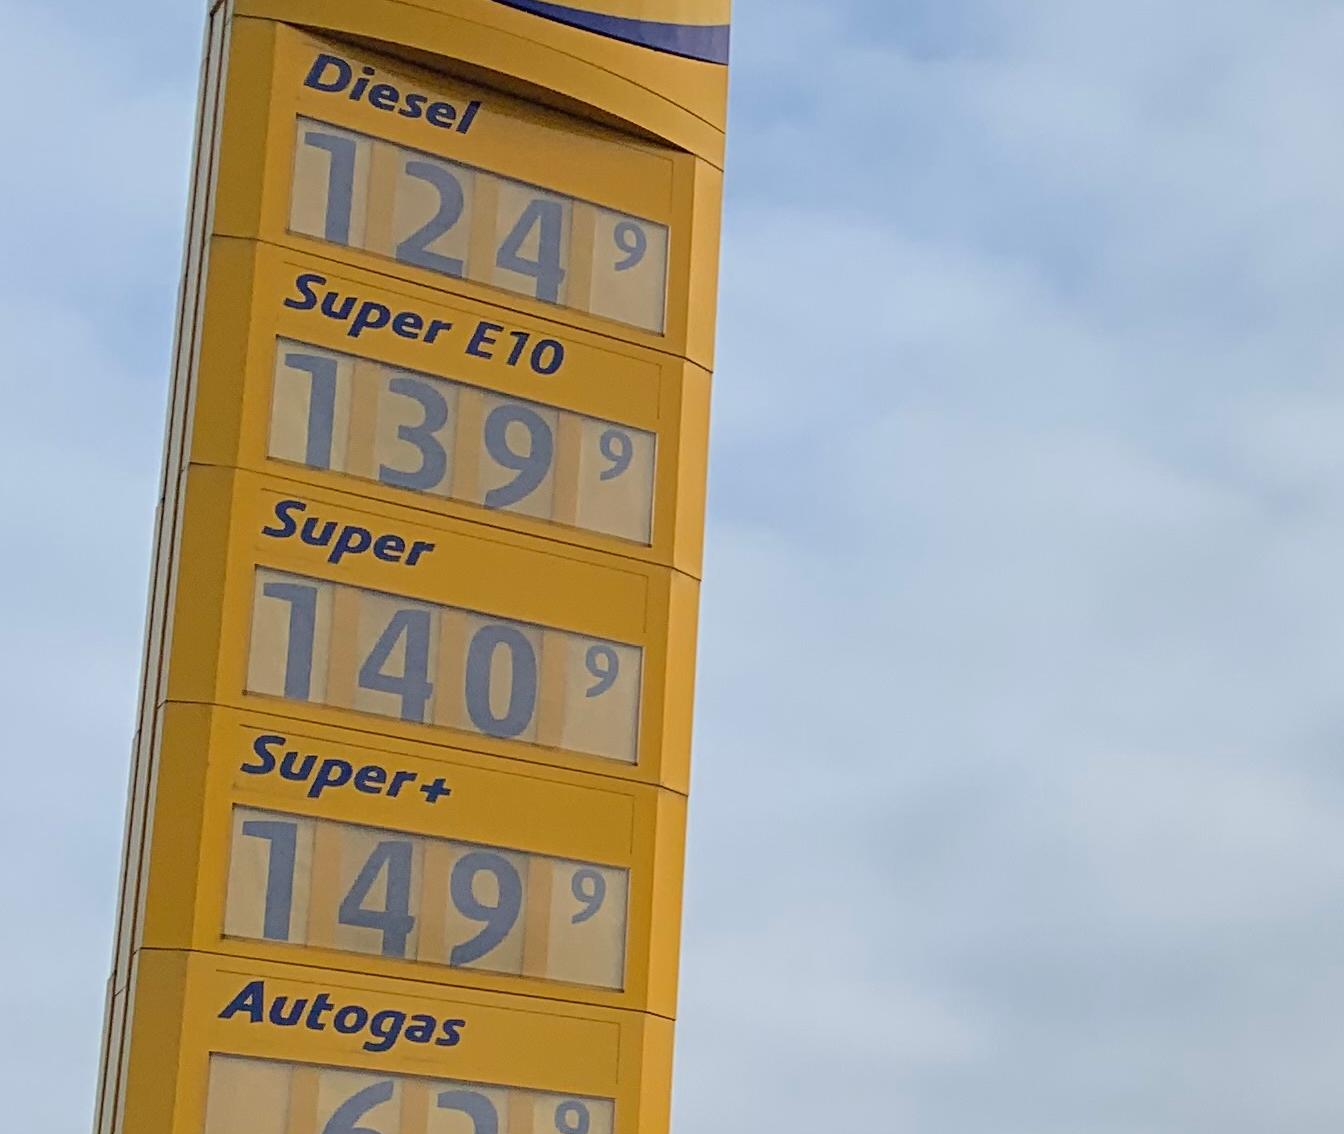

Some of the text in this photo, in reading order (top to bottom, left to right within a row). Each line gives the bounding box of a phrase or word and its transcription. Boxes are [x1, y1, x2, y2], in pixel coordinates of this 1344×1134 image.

[303, 53, 482, 134] Diesel
[284, 273, 566, 376] Super E10
[262, 500, 434, 567] Super
[240, 735, 452, 803] Super+
[218, 981, 466, 1052] Autogas
